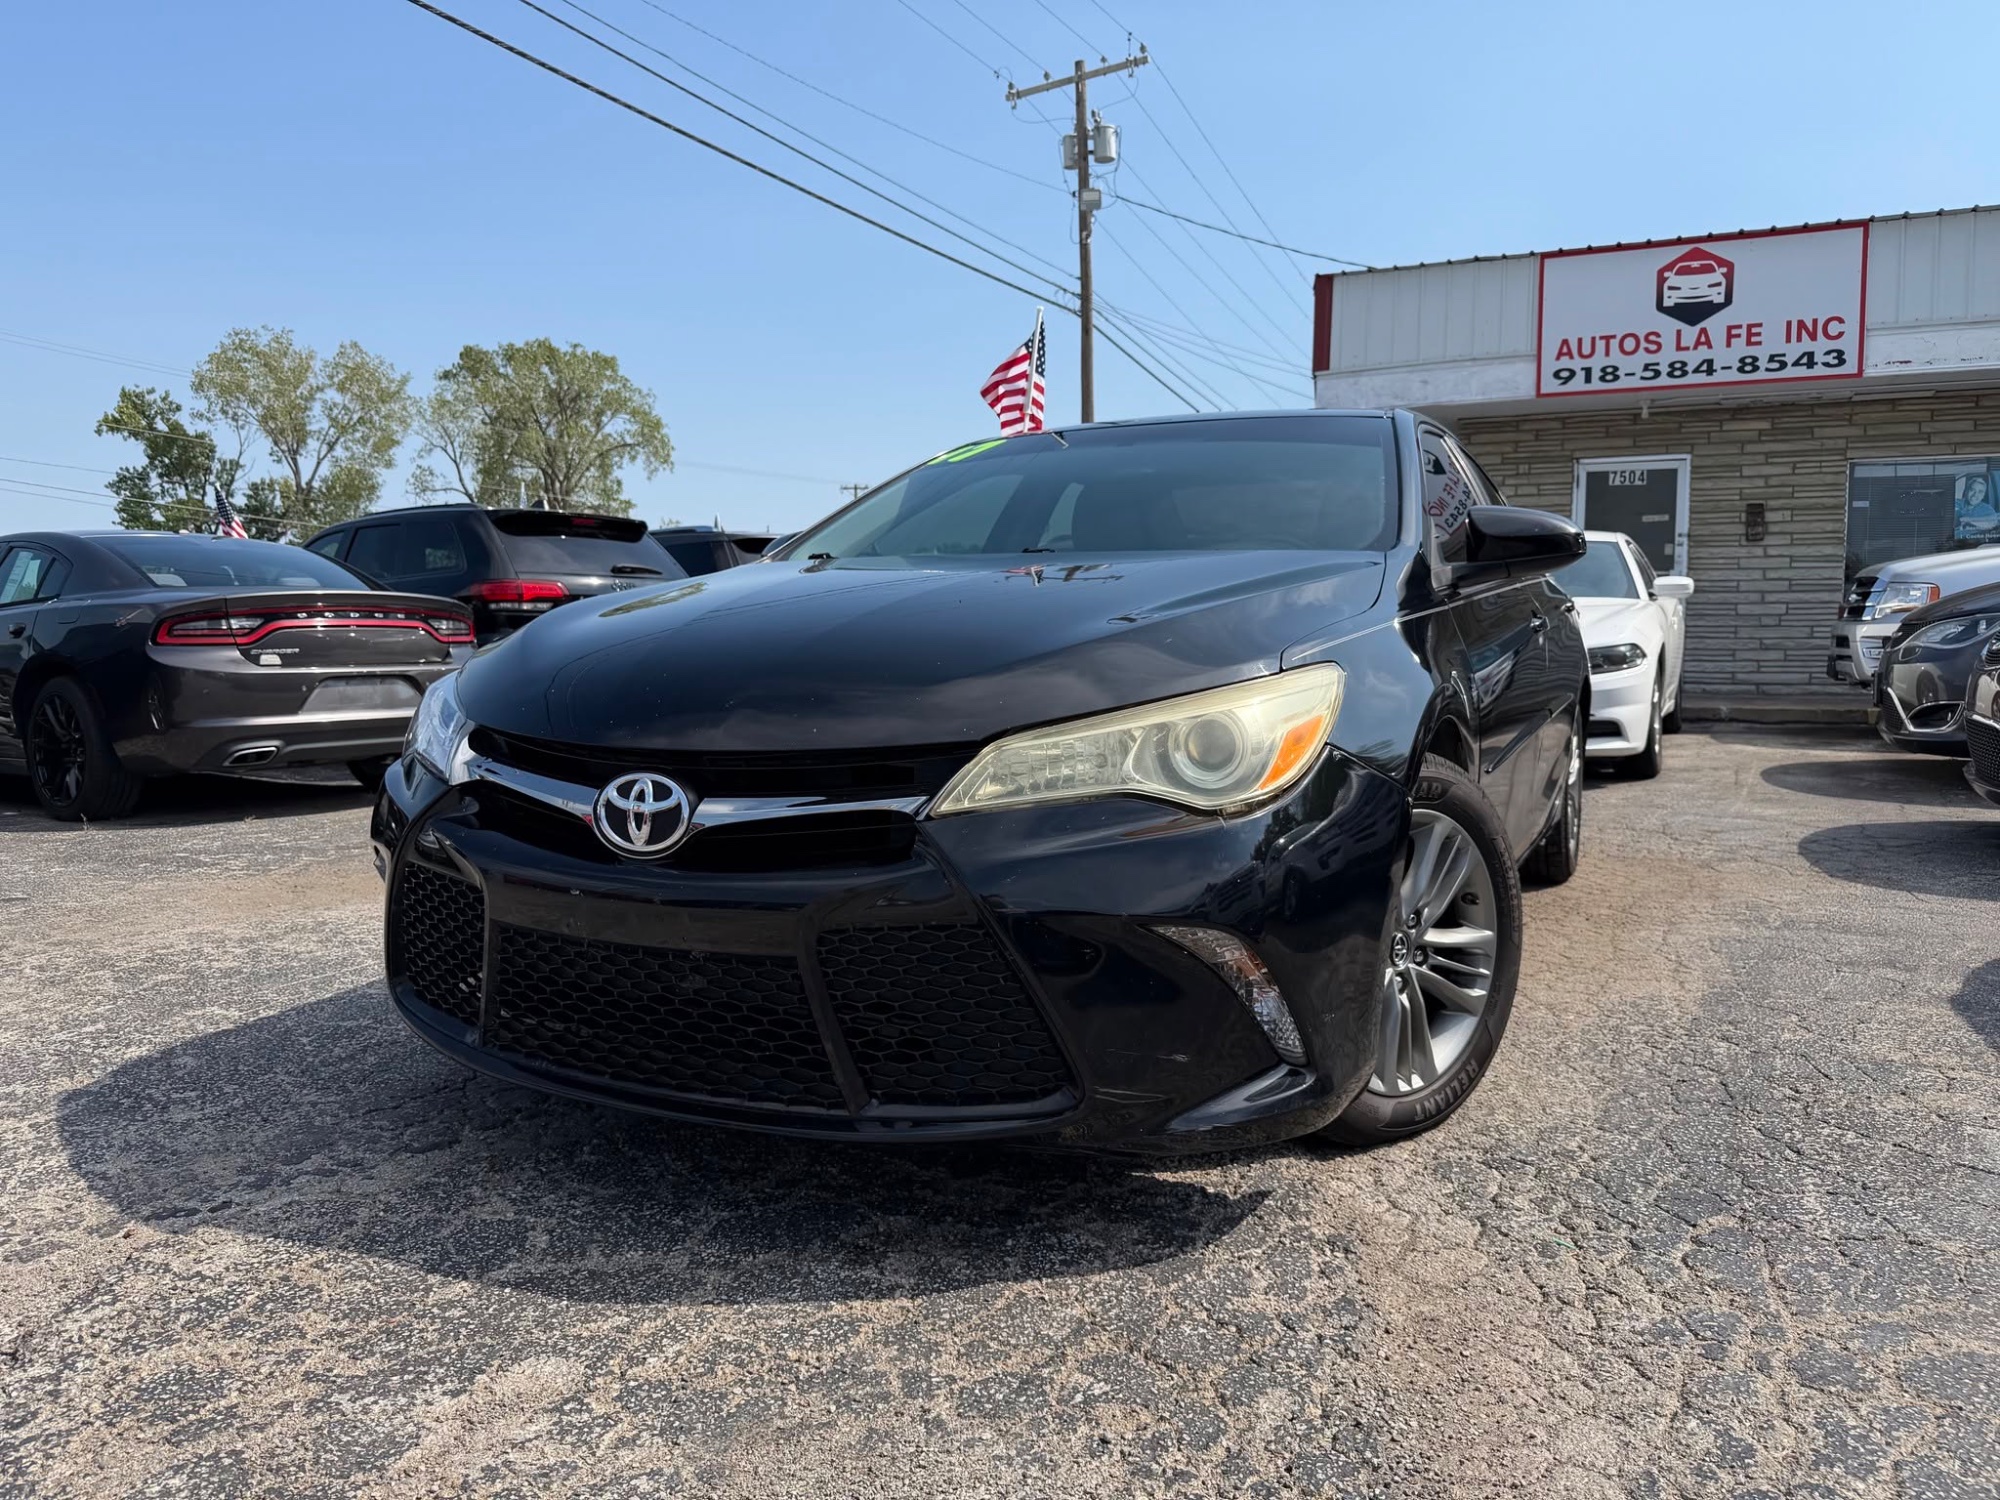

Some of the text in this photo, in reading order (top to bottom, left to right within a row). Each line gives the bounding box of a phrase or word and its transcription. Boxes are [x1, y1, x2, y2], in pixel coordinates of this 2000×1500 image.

[1555, 316, 1846, 361] AUTOS LA FE INC
[1552, 349, 1847, 386] 918-584-8543
[1610, 470, 1646, 485] 7504
[1414, 1058, 1479, 1121] RELIANT
